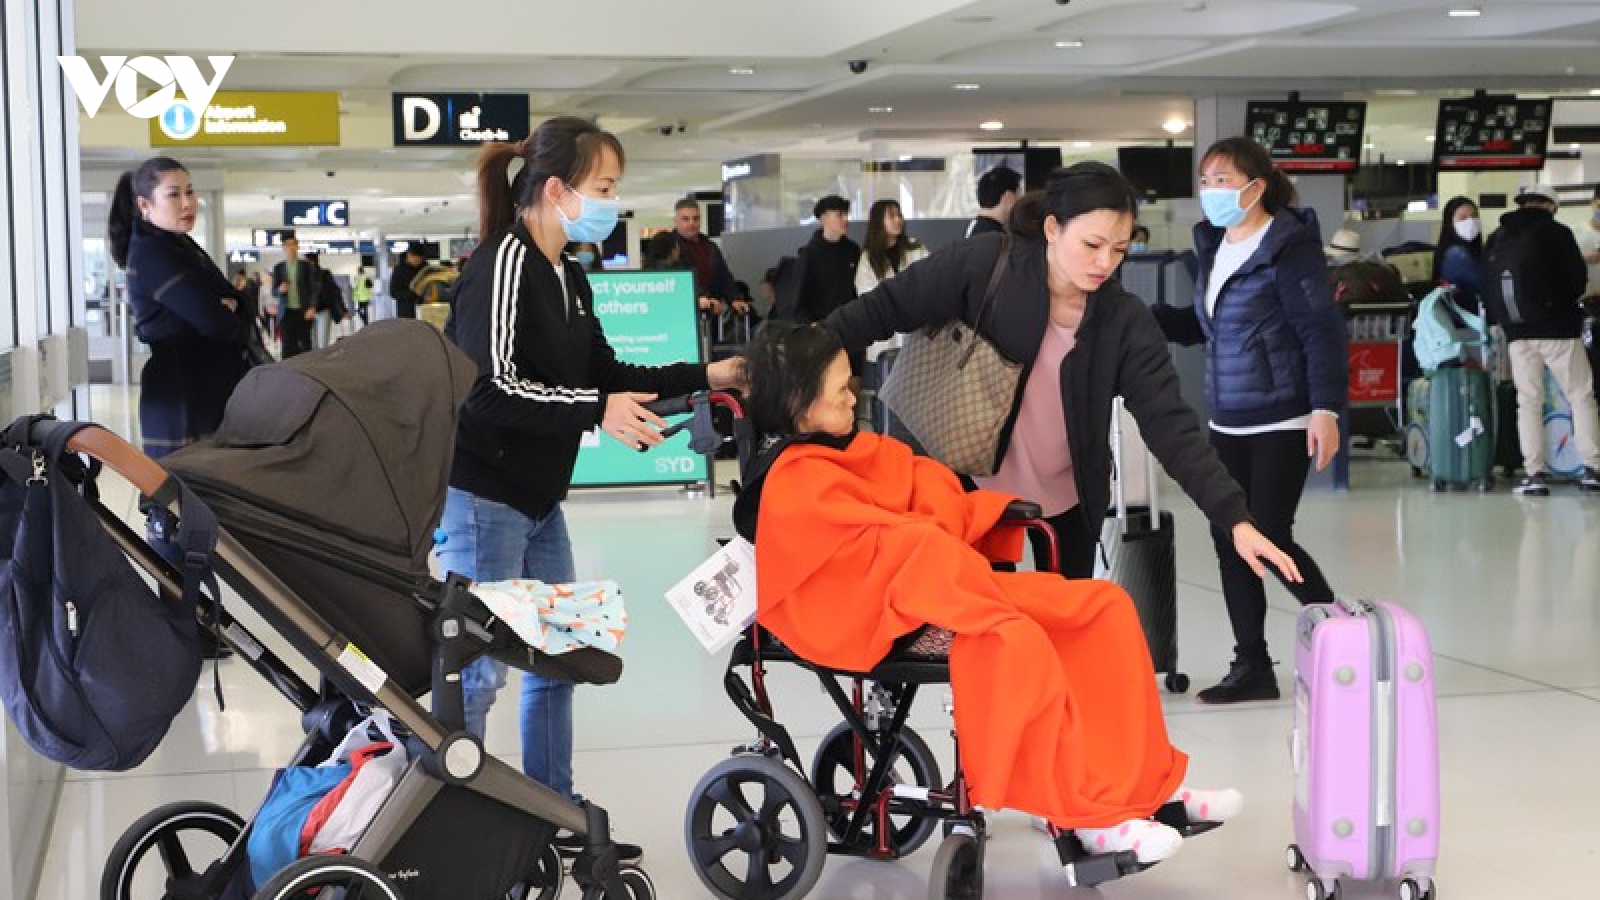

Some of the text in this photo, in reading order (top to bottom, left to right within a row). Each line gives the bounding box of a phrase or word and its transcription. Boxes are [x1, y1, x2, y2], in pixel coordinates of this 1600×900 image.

[204, 118, 287, 134] Information
[402, 97, 440, 140] D
[460, 128, 508, 141] Check-in
[326, 202, 345, 225] C
[612, 278, 676, 297] yourself
[597, 300, 649, 315] others
[655, 456, 695, 474] SYD
